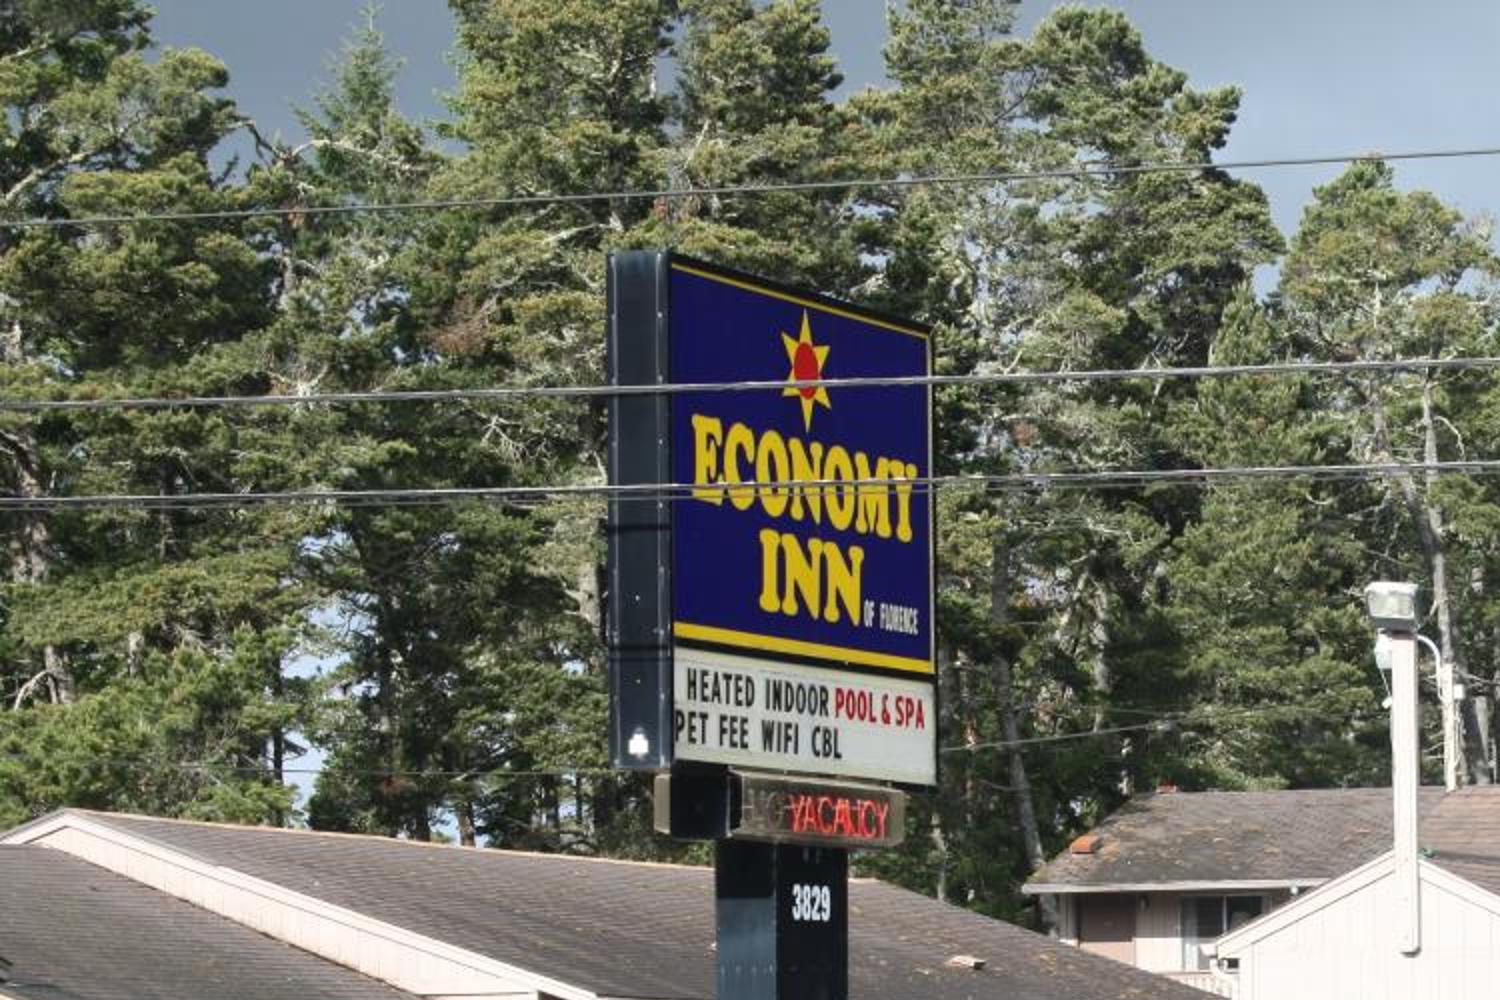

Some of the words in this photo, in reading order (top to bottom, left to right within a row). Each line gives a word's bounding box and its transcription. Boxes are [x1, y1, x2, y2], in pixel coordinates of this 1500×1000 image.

[692, 413, 918, 543] ECONOMY
[759, 529, 864, 626] INN
[863, 599, 875, 628] OF
[687, 667, 755, 707] HEATED
[765, 679, 830, 718] INDOOR
[834, 687, 877, 723] POOL
[881, 694, 892, 726] &
[895, 696, 926, 731] SPA
[675, 710, 709, 745] PET
[719, 715, 749, 750] FEE
[761, 719, 799, 756] WIFI
[811, 726, 843, 760] CBL
[790, 794, 889, 839] VACANCY
[791, 883, 831, 922] 3829
